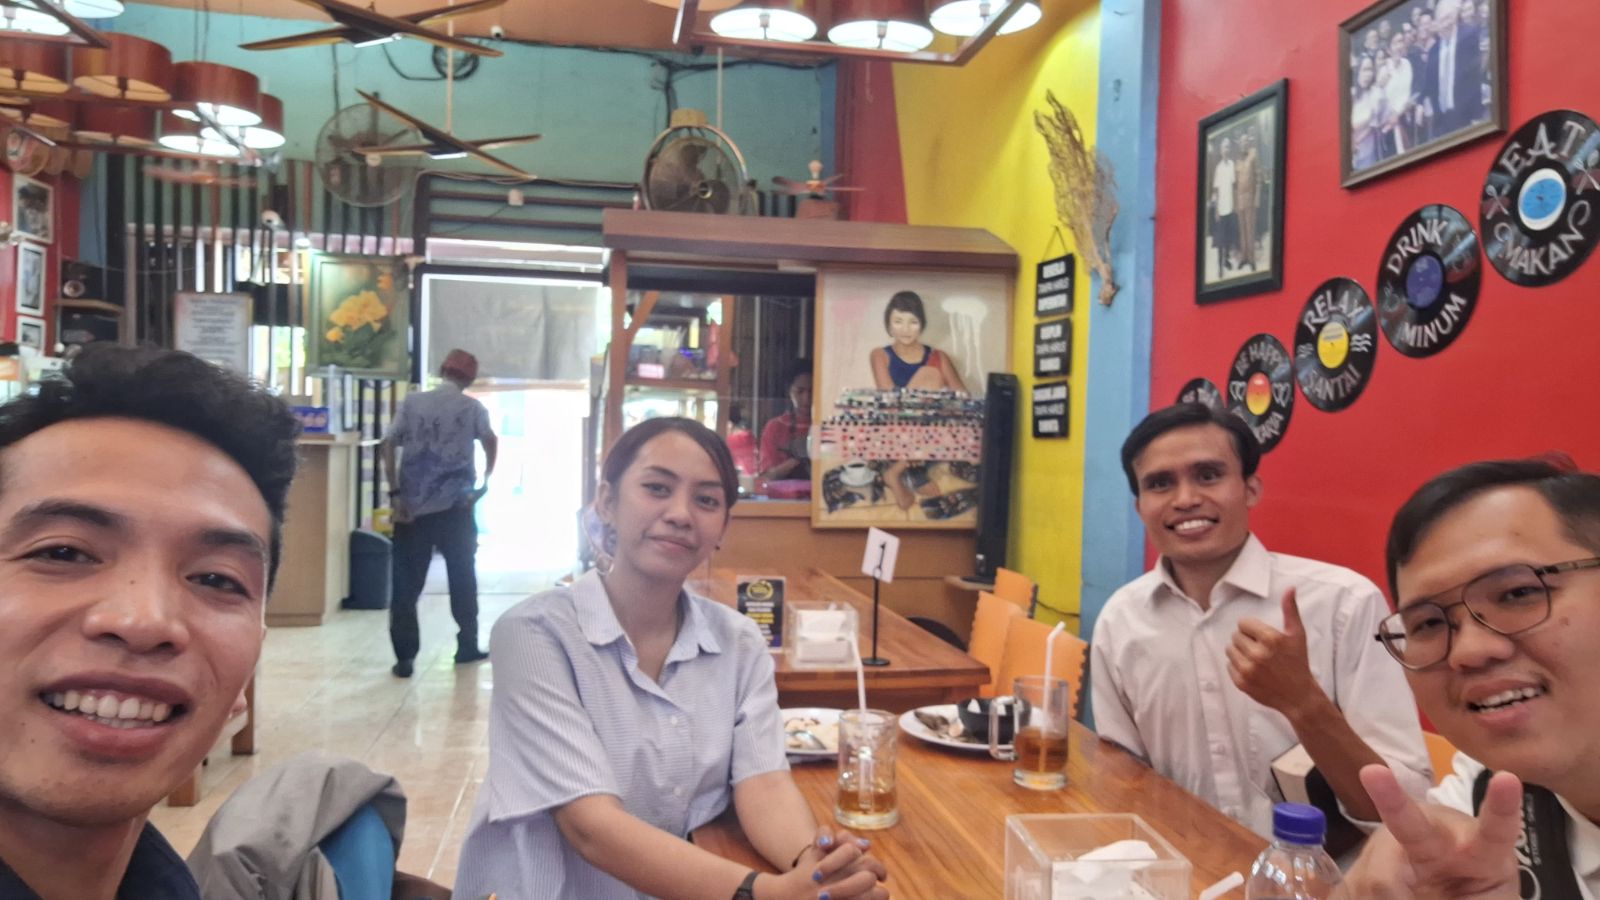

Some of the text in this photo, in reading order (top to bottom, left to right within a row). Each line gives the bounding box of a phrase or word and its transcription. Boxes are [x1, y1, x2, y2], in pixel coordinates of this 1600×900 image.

[1499, 120, 1586, 177] EAT
[1386, 219, 1448, 276] DRINK
[1494, 200, 1591, 275] MAKAN
[1303, 290, 1363, 335] RELAX
[1401, 294, 1467, 348] MINUM
[1306, 364, 1362, 401] SANTAI
